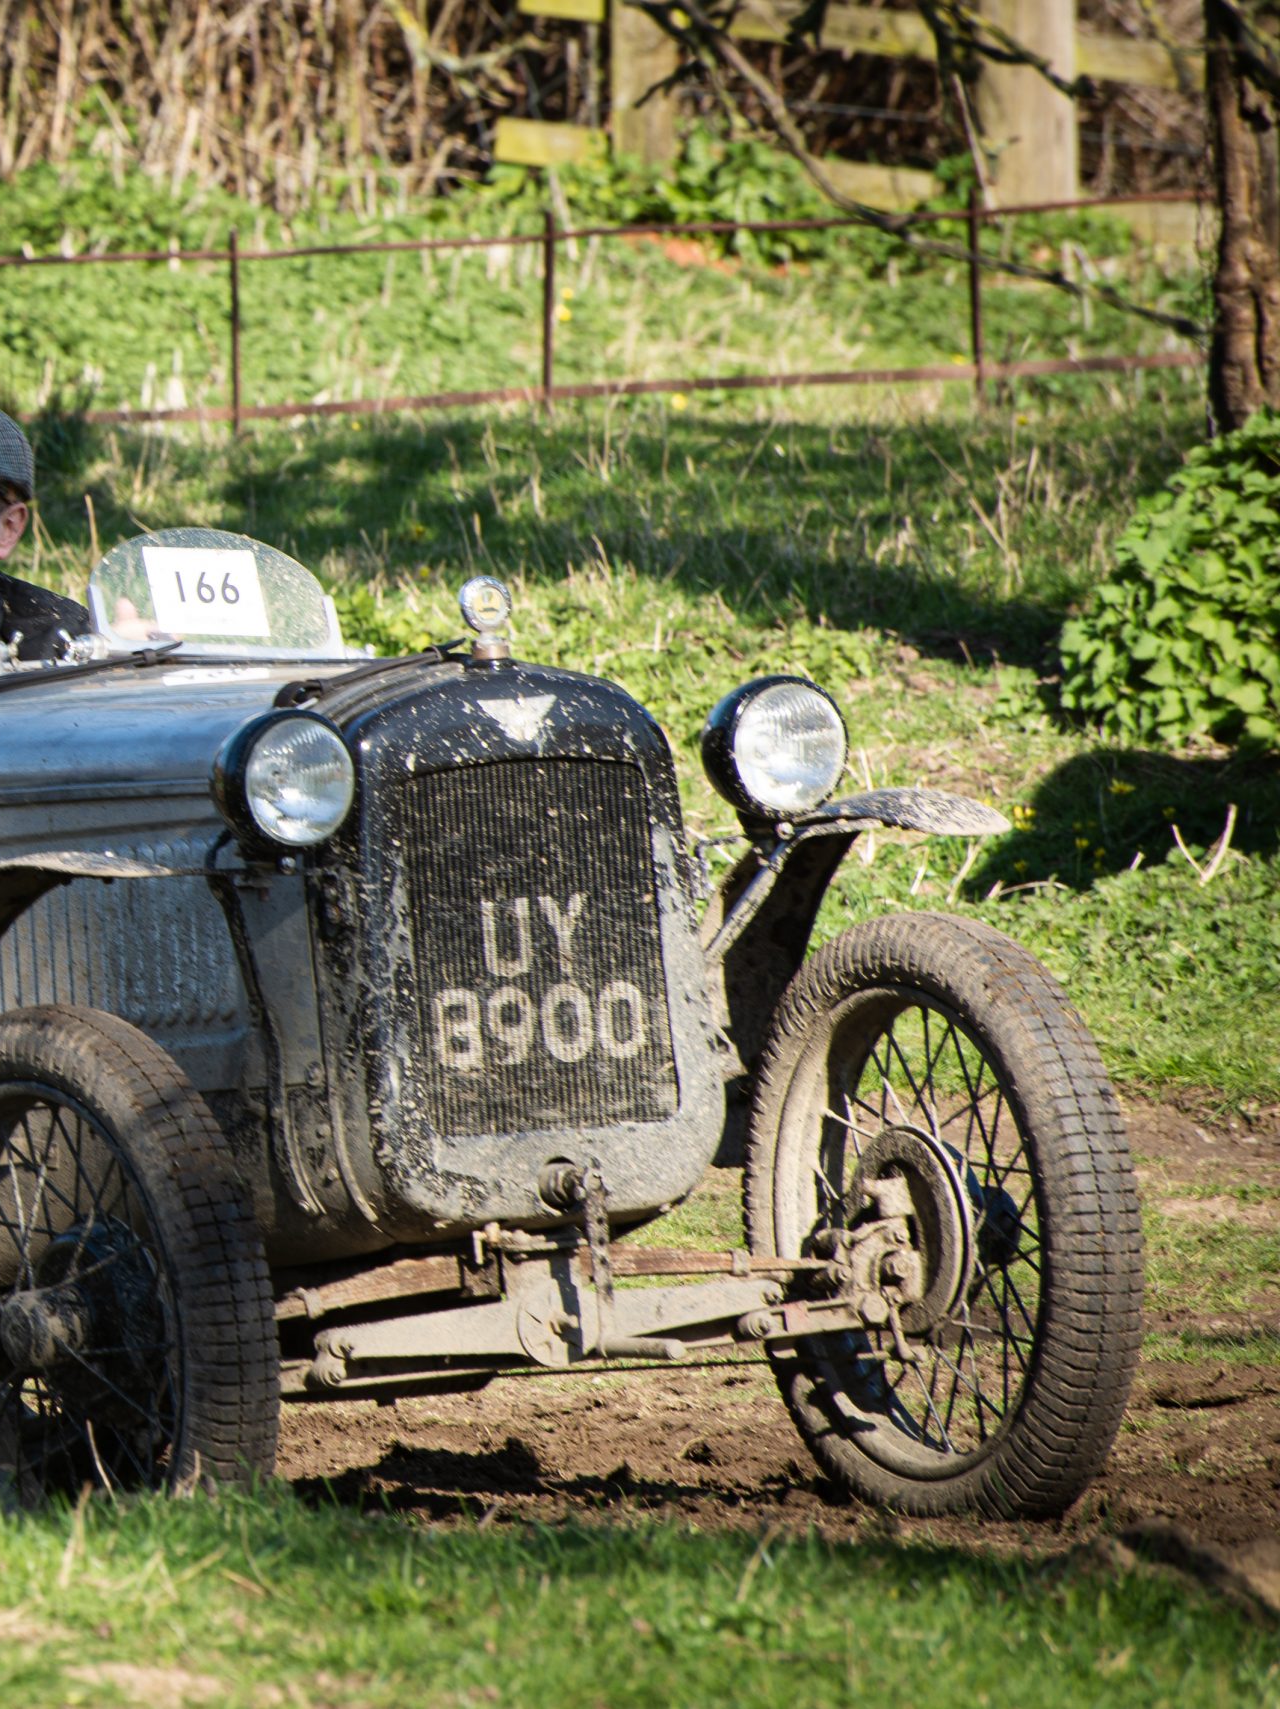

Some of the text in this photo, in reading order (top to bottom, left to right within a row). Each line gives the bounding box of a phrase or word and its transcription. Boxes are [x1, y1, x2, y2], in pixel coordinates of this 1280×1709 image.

[175, 571, 240, 604] 166
[480, 893, 586, 977] UY
[432, 981, 647, 1070] 8900
